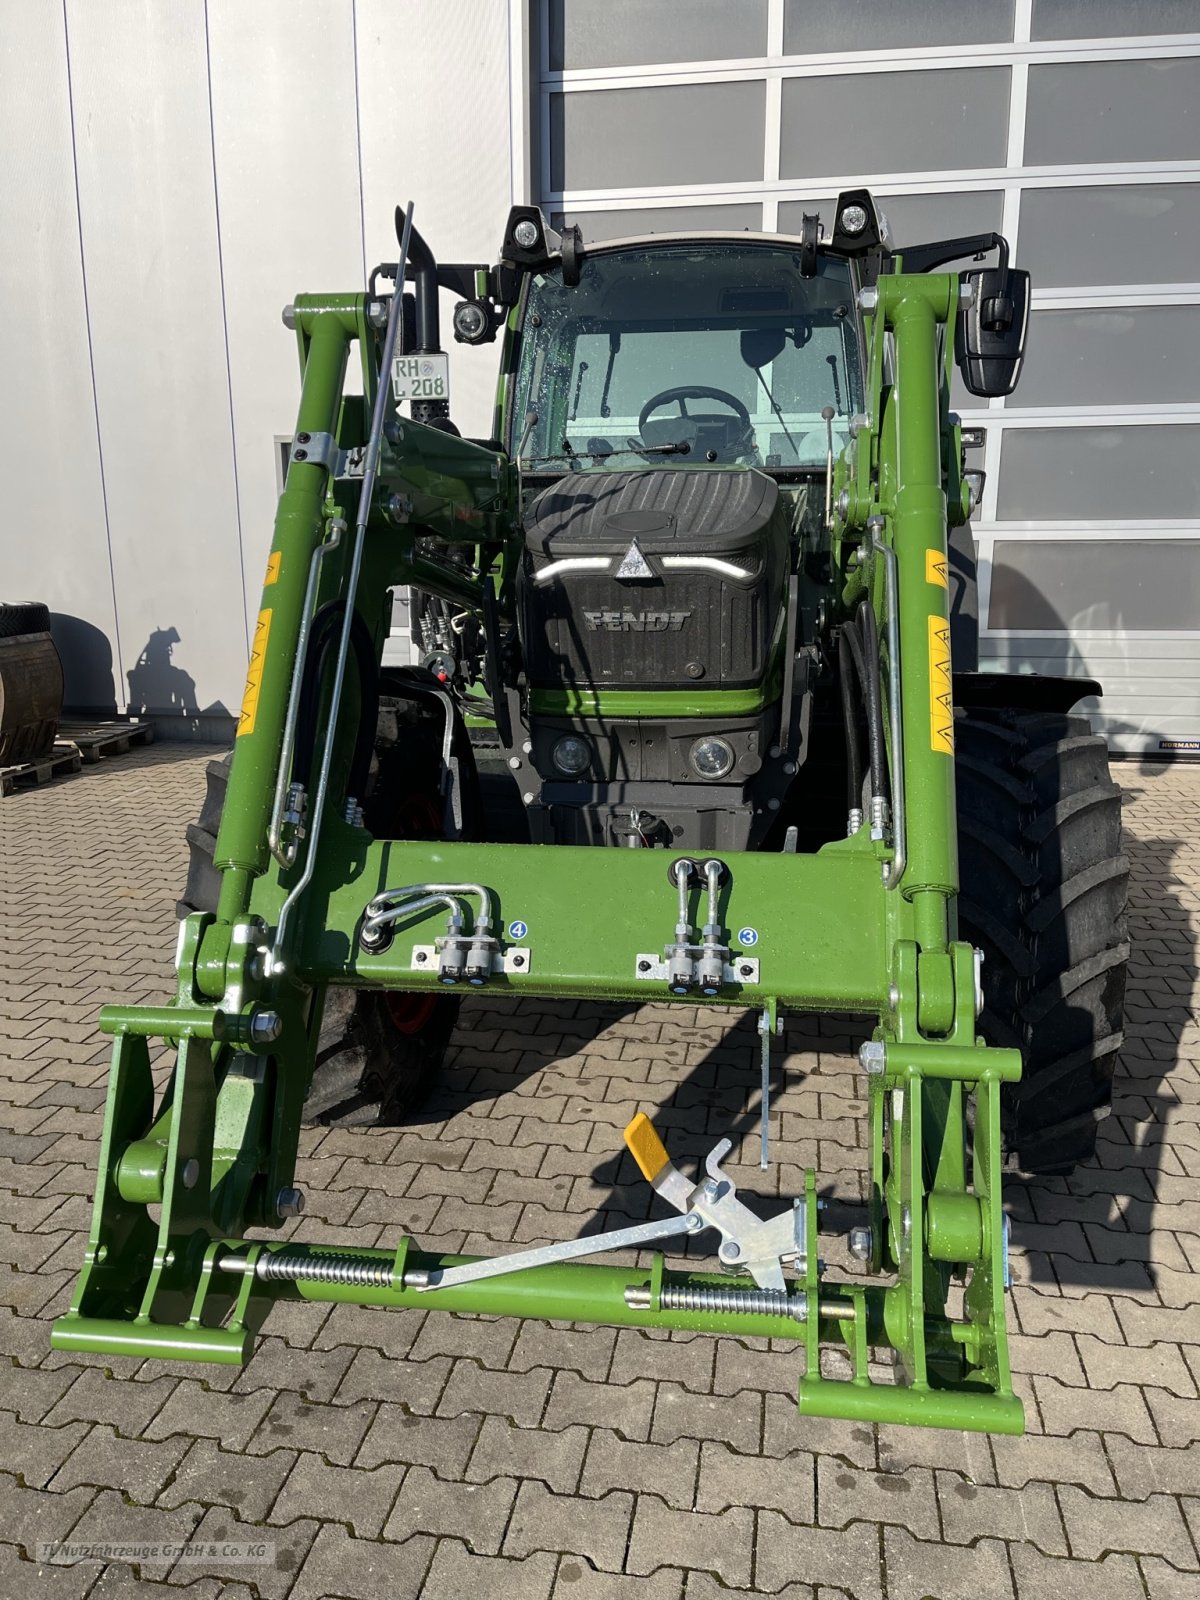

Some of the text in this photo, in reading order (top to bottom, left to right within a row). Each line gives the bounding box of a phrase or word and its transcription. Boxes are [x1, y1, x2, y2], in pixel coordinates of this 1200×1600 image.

[395, 359, 419, 377] RH
[395, 377, 444, 397] L 208
[583, 611, 691, 632] FENDT
[511, 923, 524, 937] 4
[741, 930, 754, 944] 3
